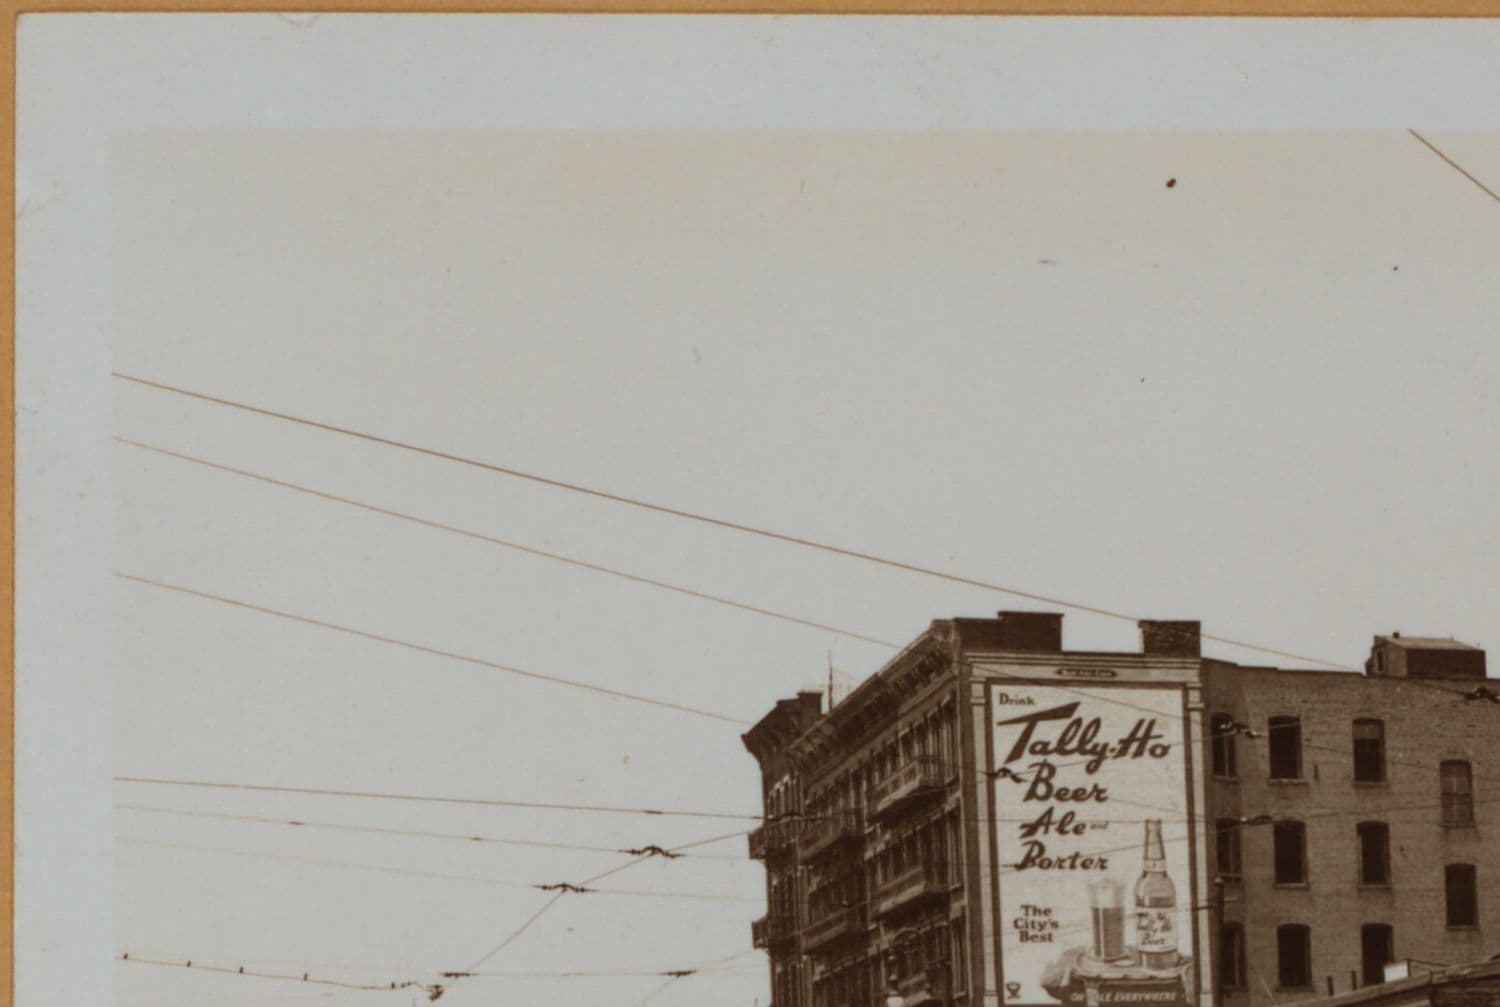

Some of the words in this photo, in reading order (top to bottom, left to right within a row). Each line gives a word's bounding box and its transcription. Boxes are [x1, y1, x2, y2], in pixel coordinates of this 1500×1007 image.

[1000, 693, 1034, 705] Drink
[1023, 758, 1109, 802] Beer
[1019, 806, 1087, 839] Ale
[1015, 840, 1108, 871] Porter
[1020, 904, 1052, 916] The
[1014, 918, 1059, 931] City's
[1019, 930, 1053, 942] Best
